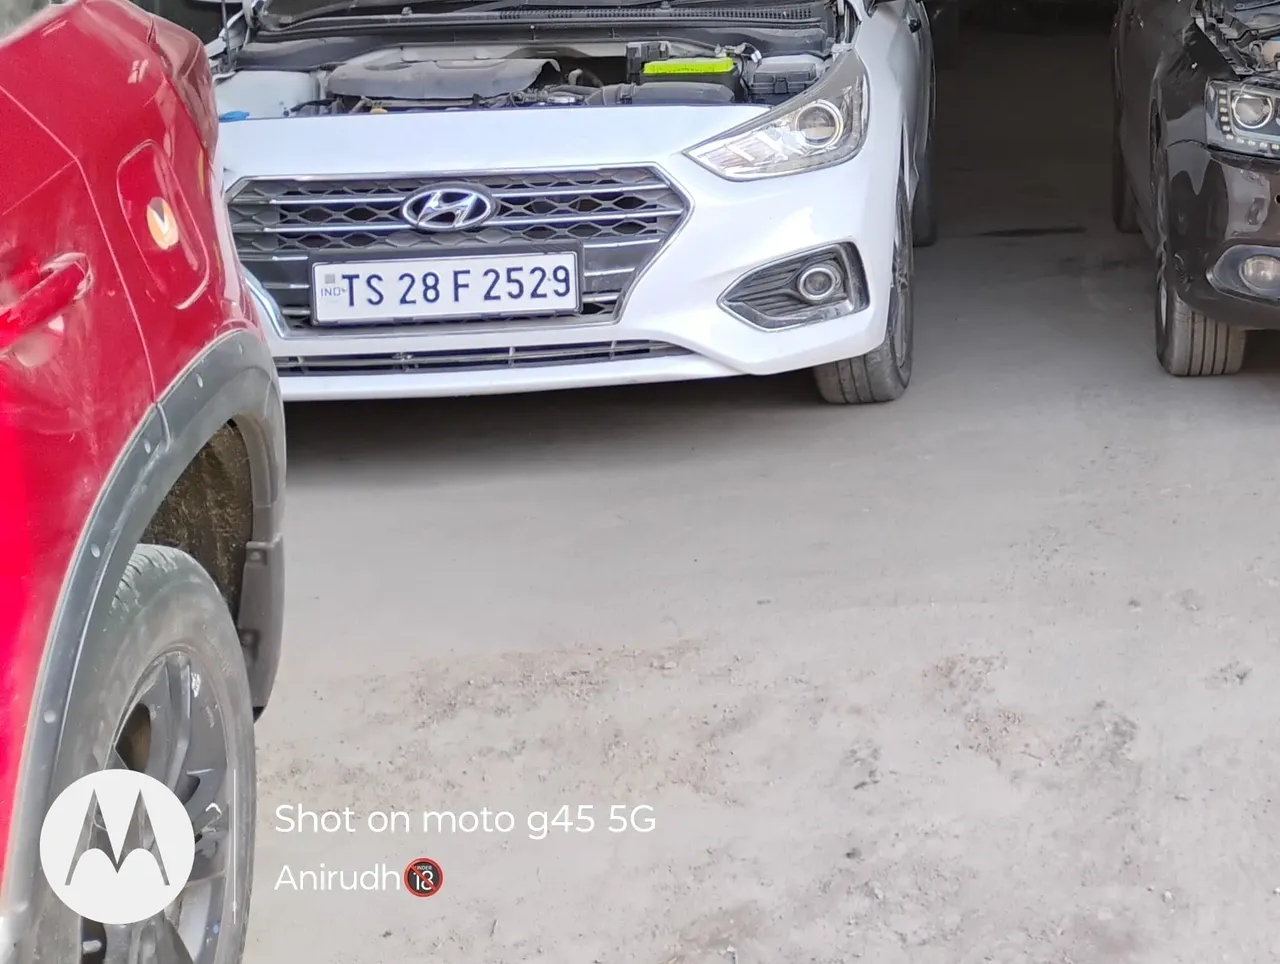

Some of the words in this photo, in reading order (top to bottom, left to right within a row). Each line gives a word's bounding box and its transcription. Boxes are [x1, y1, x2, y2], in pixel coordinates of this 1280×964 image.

[341, 274, 384, 307] TS
[399, 272, 440, 304] 28
[453, 269, 471, 302] F
[483, 265, 570, 302] 2529
